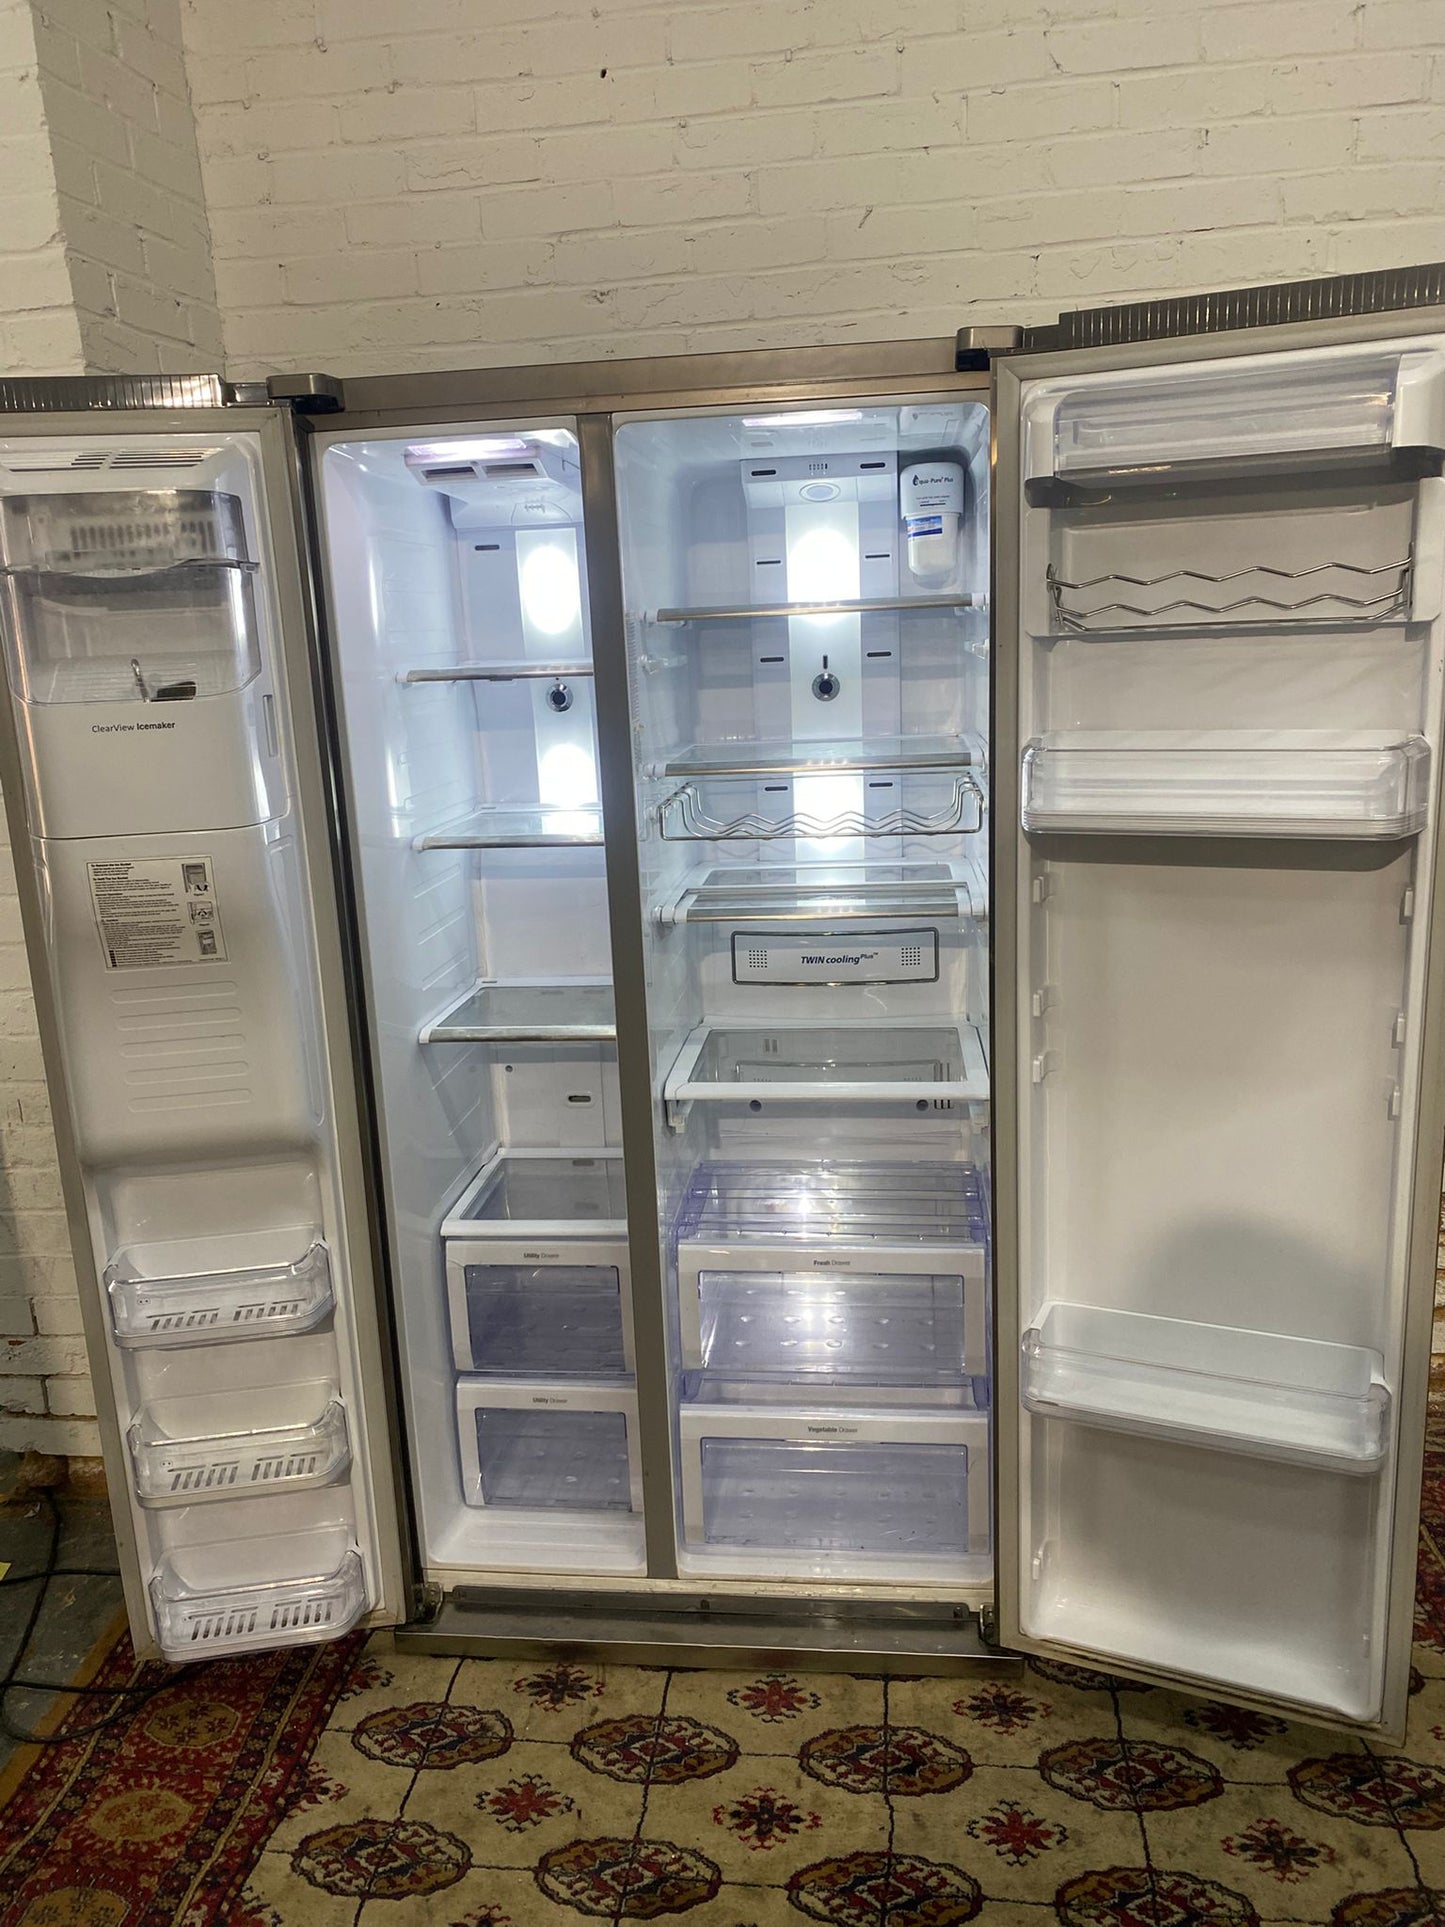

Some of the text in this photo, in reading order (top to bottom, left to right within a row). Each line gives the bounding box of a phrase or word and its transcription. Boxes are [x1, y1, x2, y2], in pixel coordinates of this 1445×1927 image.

[91, 721, 176, 733] ClearView Icemaker
[801, 956, 825, 964] TWIN
[807, 1425, 838, 1433] Vegetable
